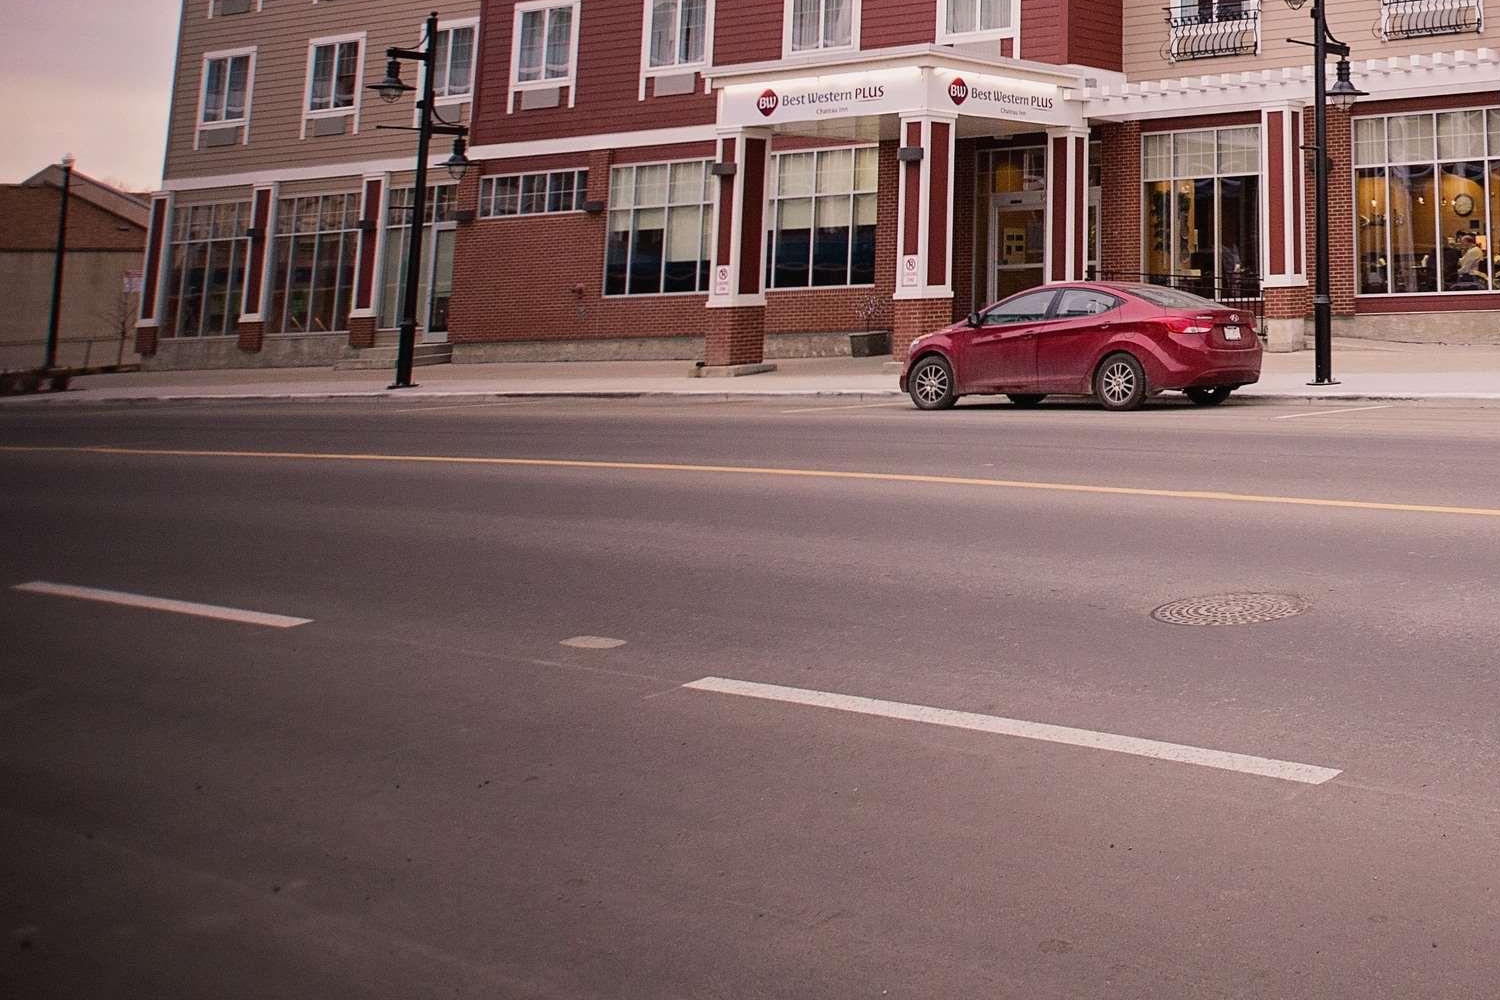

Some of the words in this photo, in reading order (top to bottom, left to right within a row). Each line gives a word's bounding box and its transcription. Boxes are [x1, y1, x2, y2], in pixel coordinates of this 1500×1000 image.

[782, 95, 805, 106] Best
[808, 91, 852, 104] Western
[855, 85, 884, 99] PLUS
[950, 84, 966, 98] BW
[971, 88, 991, 101] Best
[993, 90, 1029, 106] Western
[1030, 95, 1053, 109] PLUS
[759, 95, 777, 109] BW
